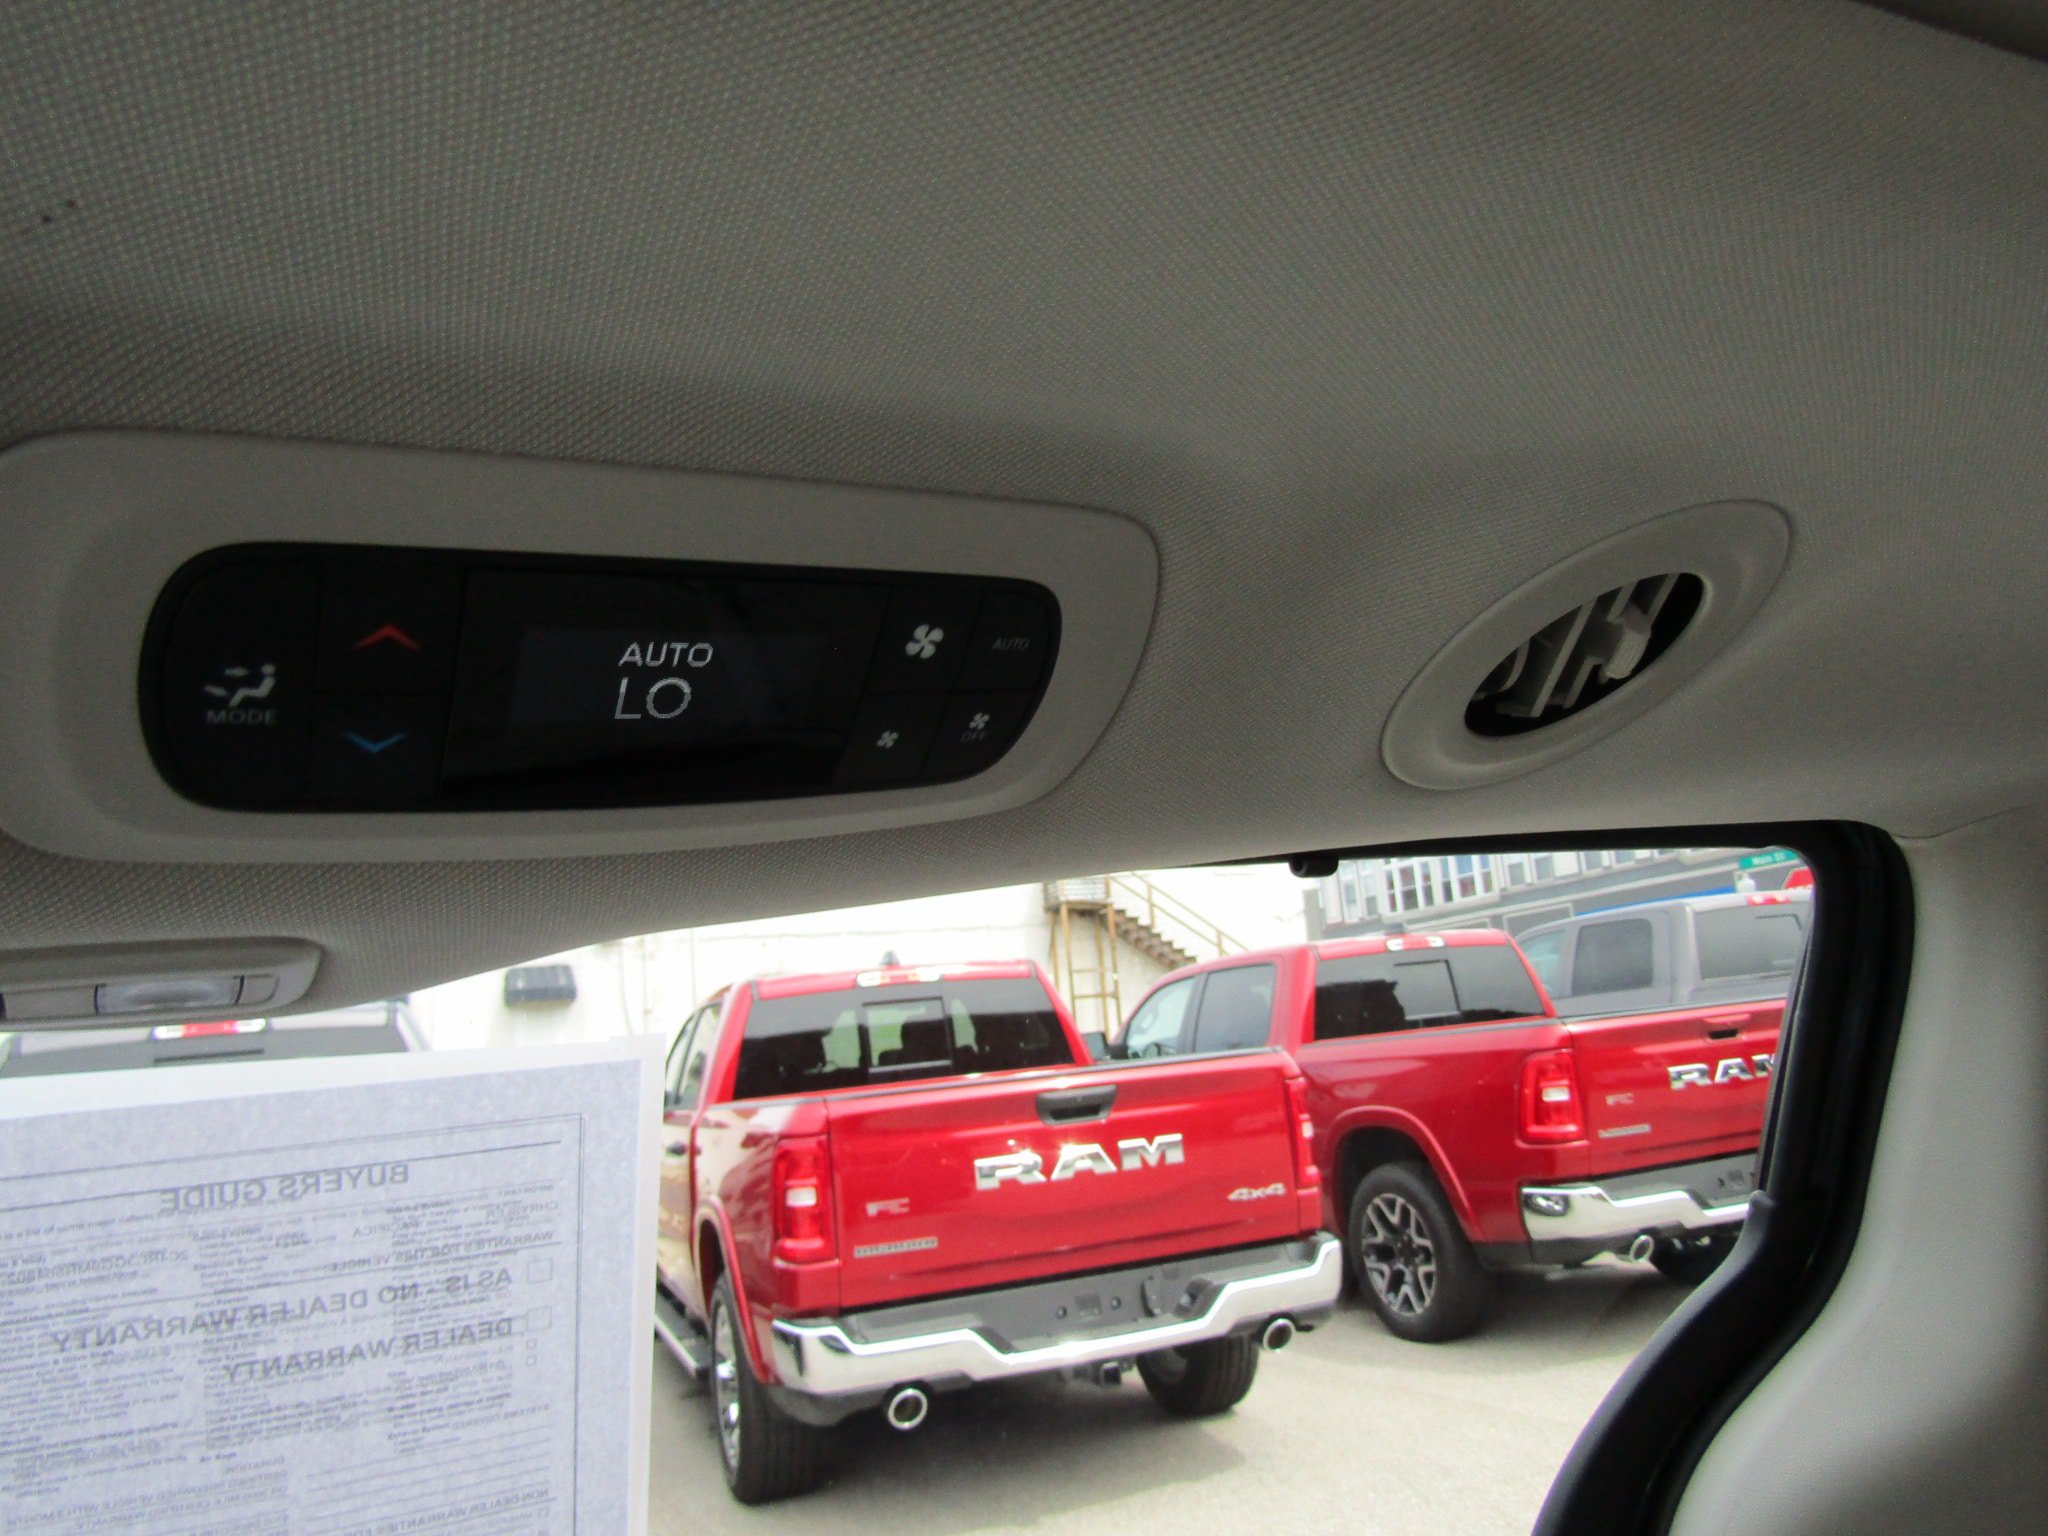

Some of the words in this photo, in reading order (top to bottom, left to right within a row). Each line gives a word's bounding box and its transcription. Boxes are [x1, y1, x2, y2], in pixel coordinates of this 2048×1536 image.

[991, 638, 1030, 650] AUTO
[618, 641, 714, 668] AUTO
[614, 676, 692, 720] LO
[206, 709, 277, 726] MODE
[960, 731, 986, 743] OFF
[974, 1133, 1185, 1191] RAM
[1227, 1182, 1285, 1201] 4x4
